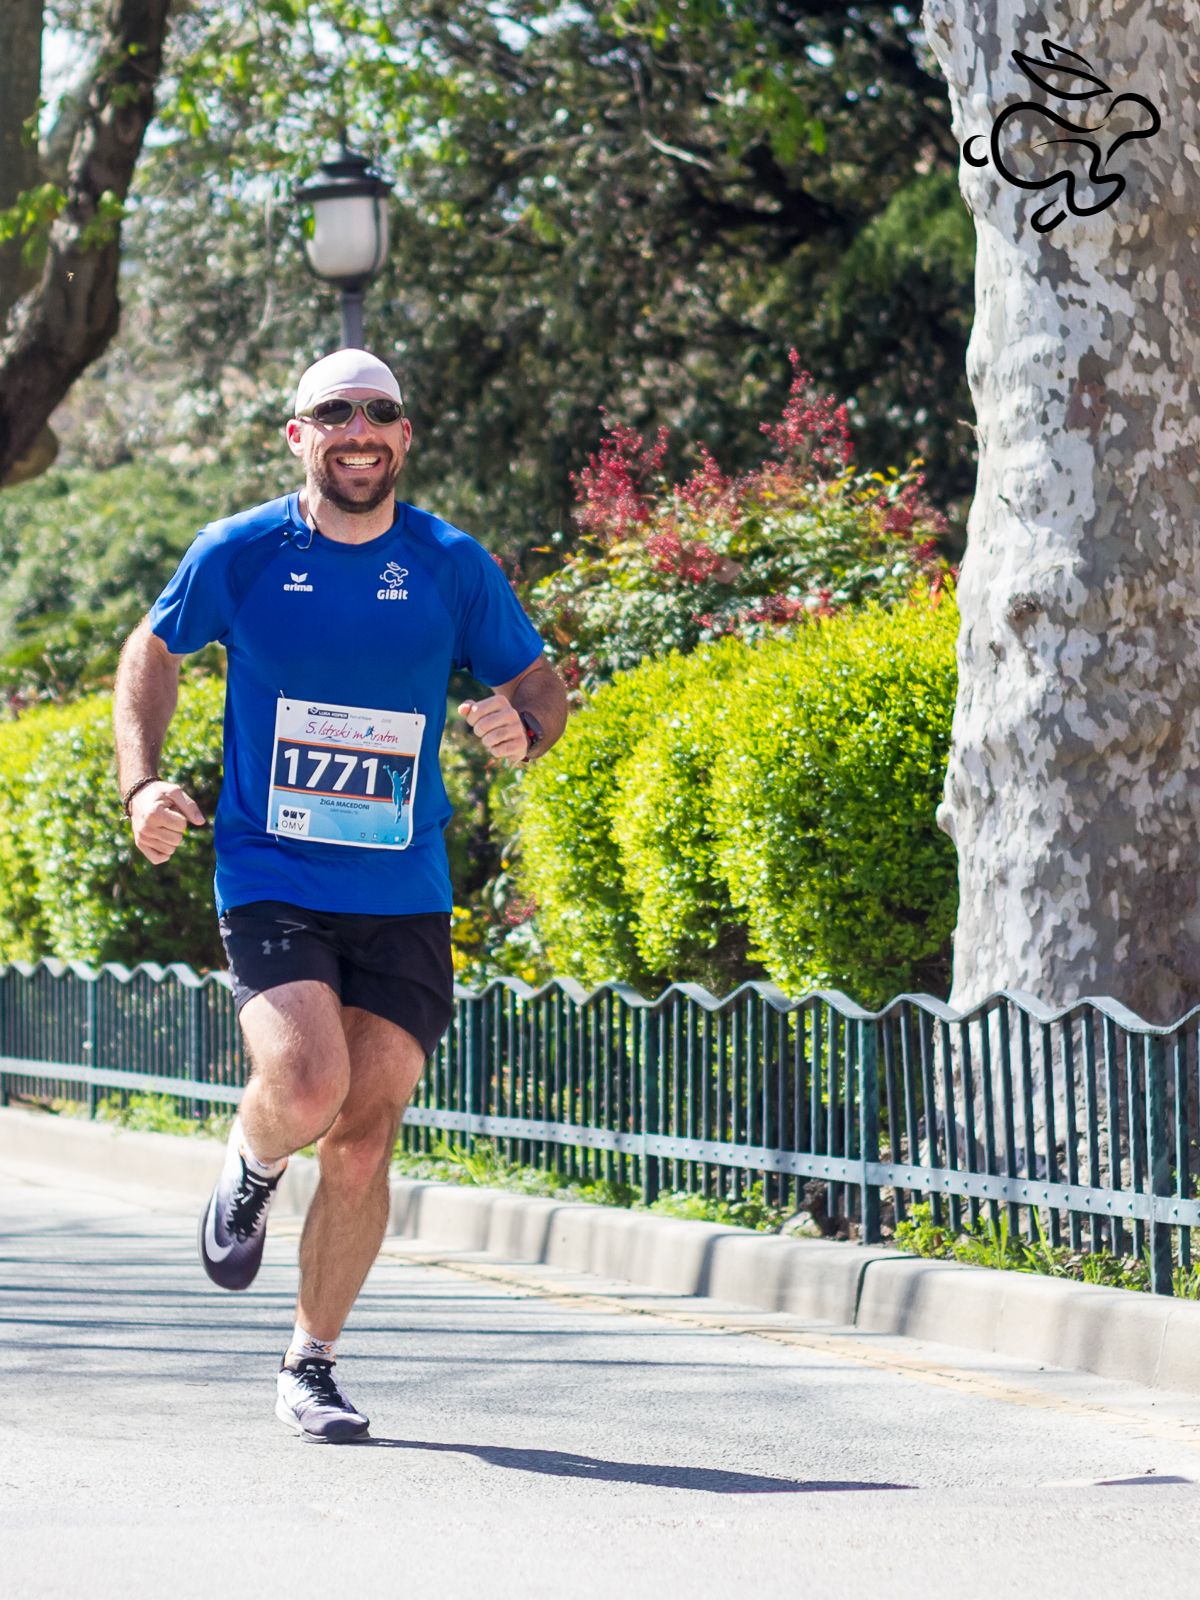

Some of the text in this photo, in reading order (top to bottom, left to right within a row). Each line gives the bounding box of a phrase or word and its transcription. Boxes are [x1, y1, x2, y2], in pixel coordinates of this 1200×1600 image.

[283, 583, 313, 592] erima
[284, 748, 379, 795] 1771
[336, 800, 370, 811] MACEDONI
[281, 820, 305, 831] OMV
